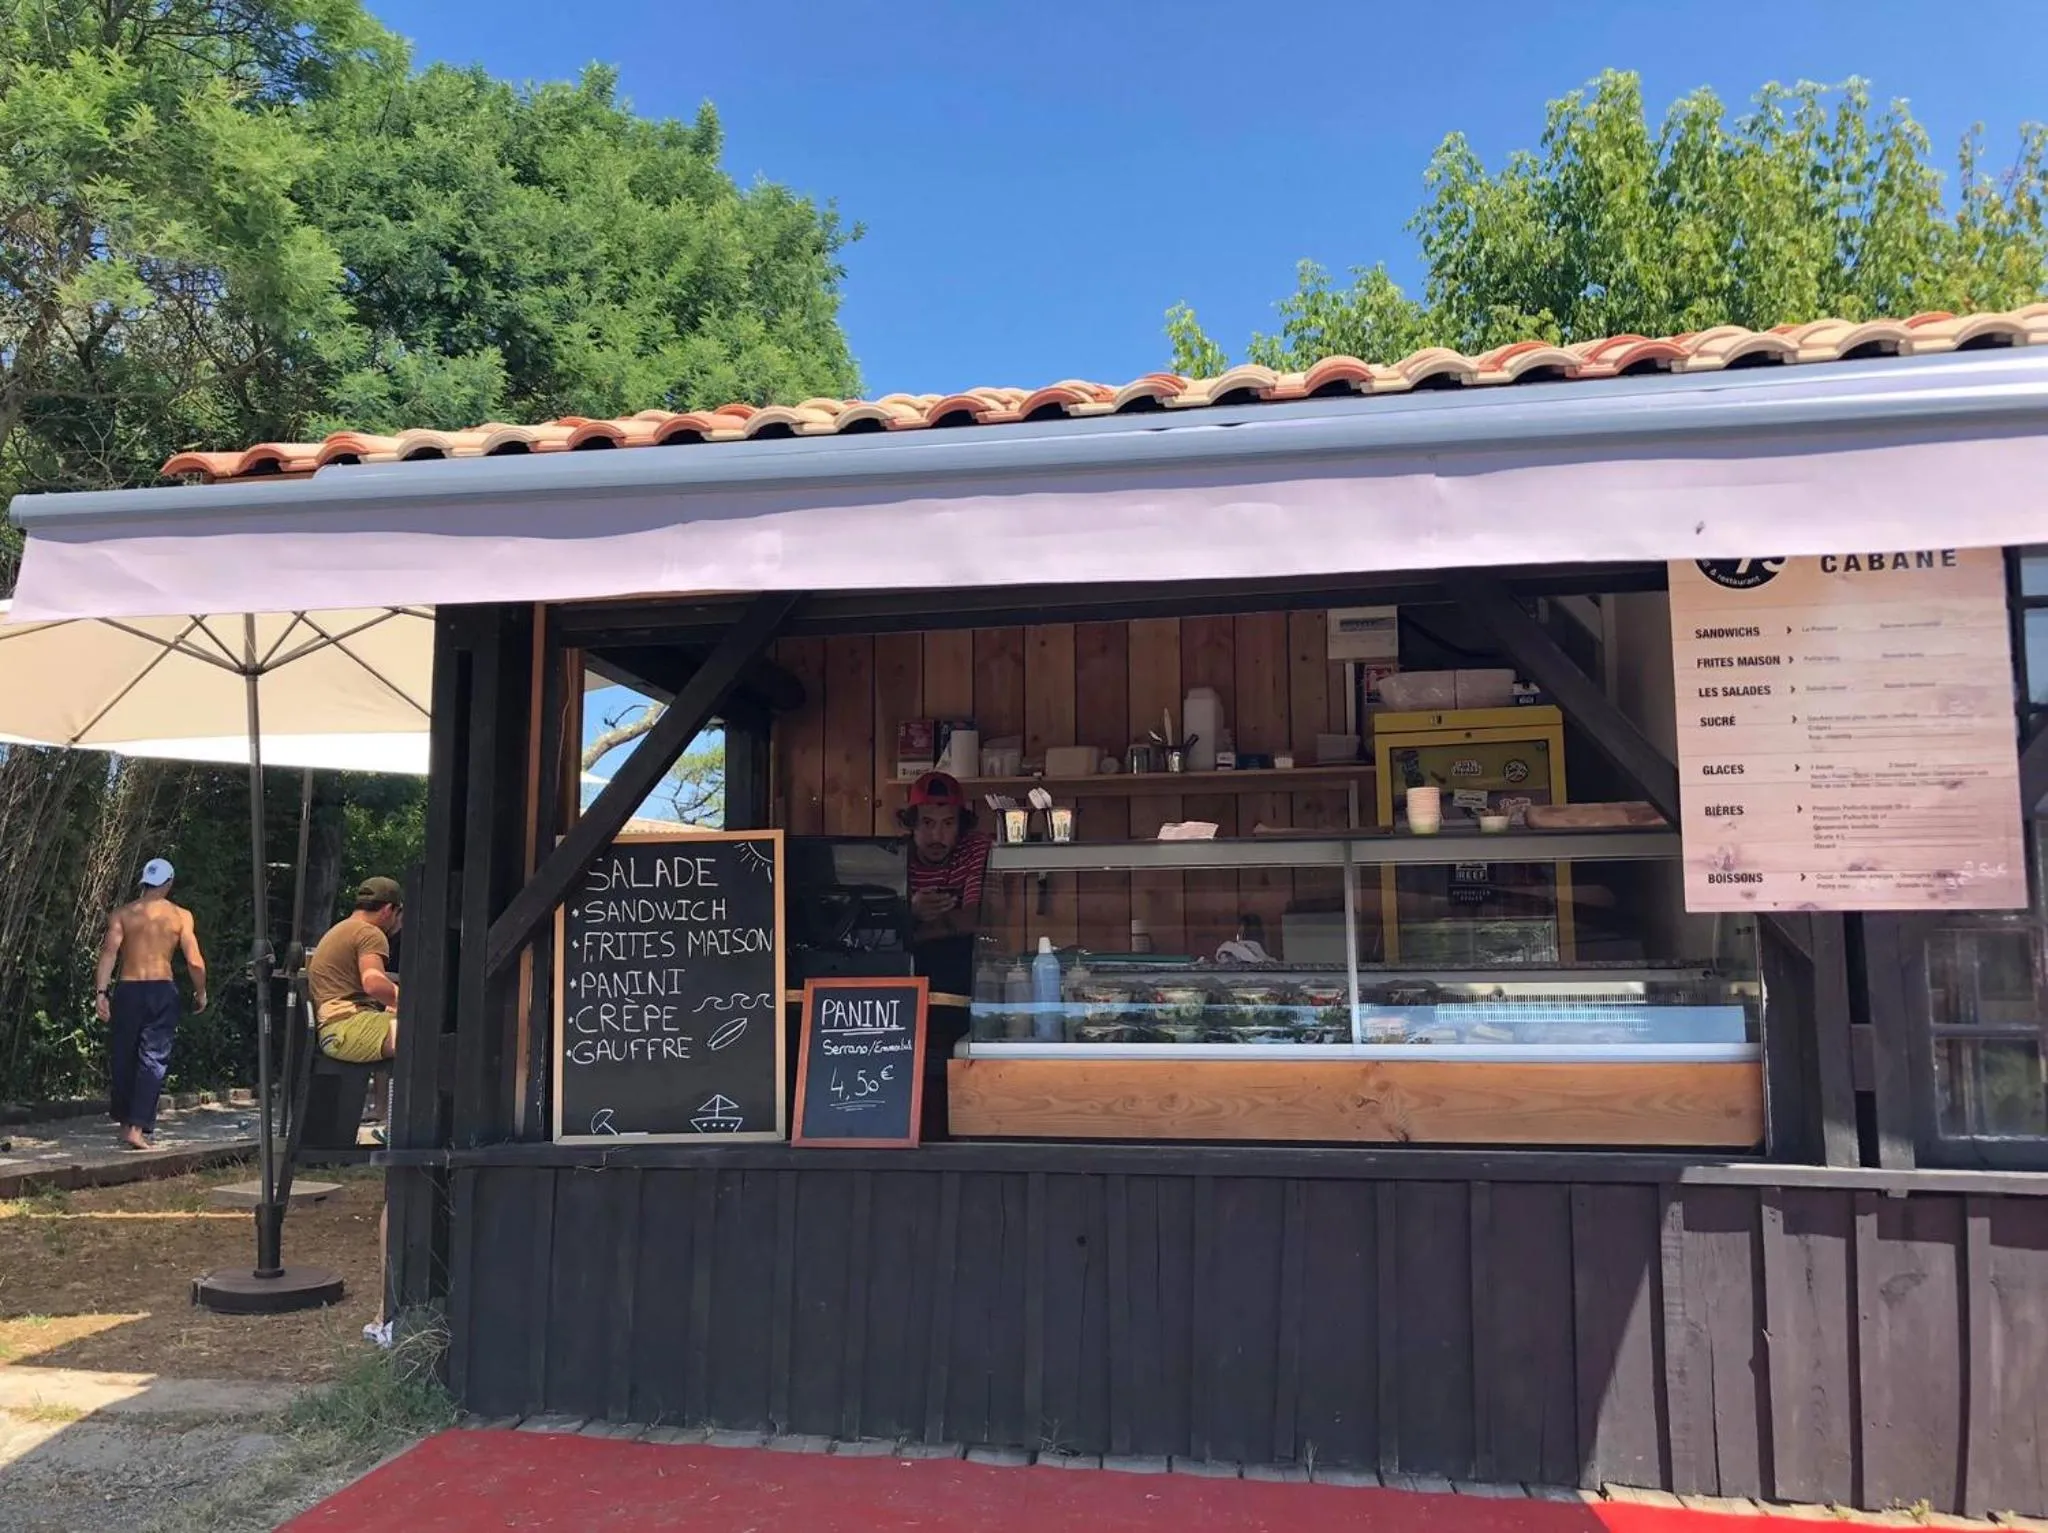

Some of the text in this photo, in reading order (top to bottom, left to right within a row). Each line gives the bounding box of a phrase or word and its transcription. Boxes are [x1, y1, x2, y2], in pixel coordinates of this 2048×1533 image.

[1820, 548, 1957, 573] CABANE
[1695, 626, 1760, 639] SANDWICHS
[1697, 655, 1781, 669] FRITES MAISON
[1698, 685, 1771, 698] LES SALADES
[1702, 764, 1744, 776] GLACES
[1704, 803, 1744, 816] BIÈRES
[585, 857, 719, 891] SALADE
[1708, 872, 1763, 884] BOISSONS
[584, 898, 727, 924] SANDWICH
[583, 927, 774, 963] FRITES MAISON
[580, 968, 686, 998] PANINI
[575, 998, 681, 1034] CRÈPE
[821, 998, 901, 1029] PANINI
[571, 1037, 694, 1065] GAUFFRE
